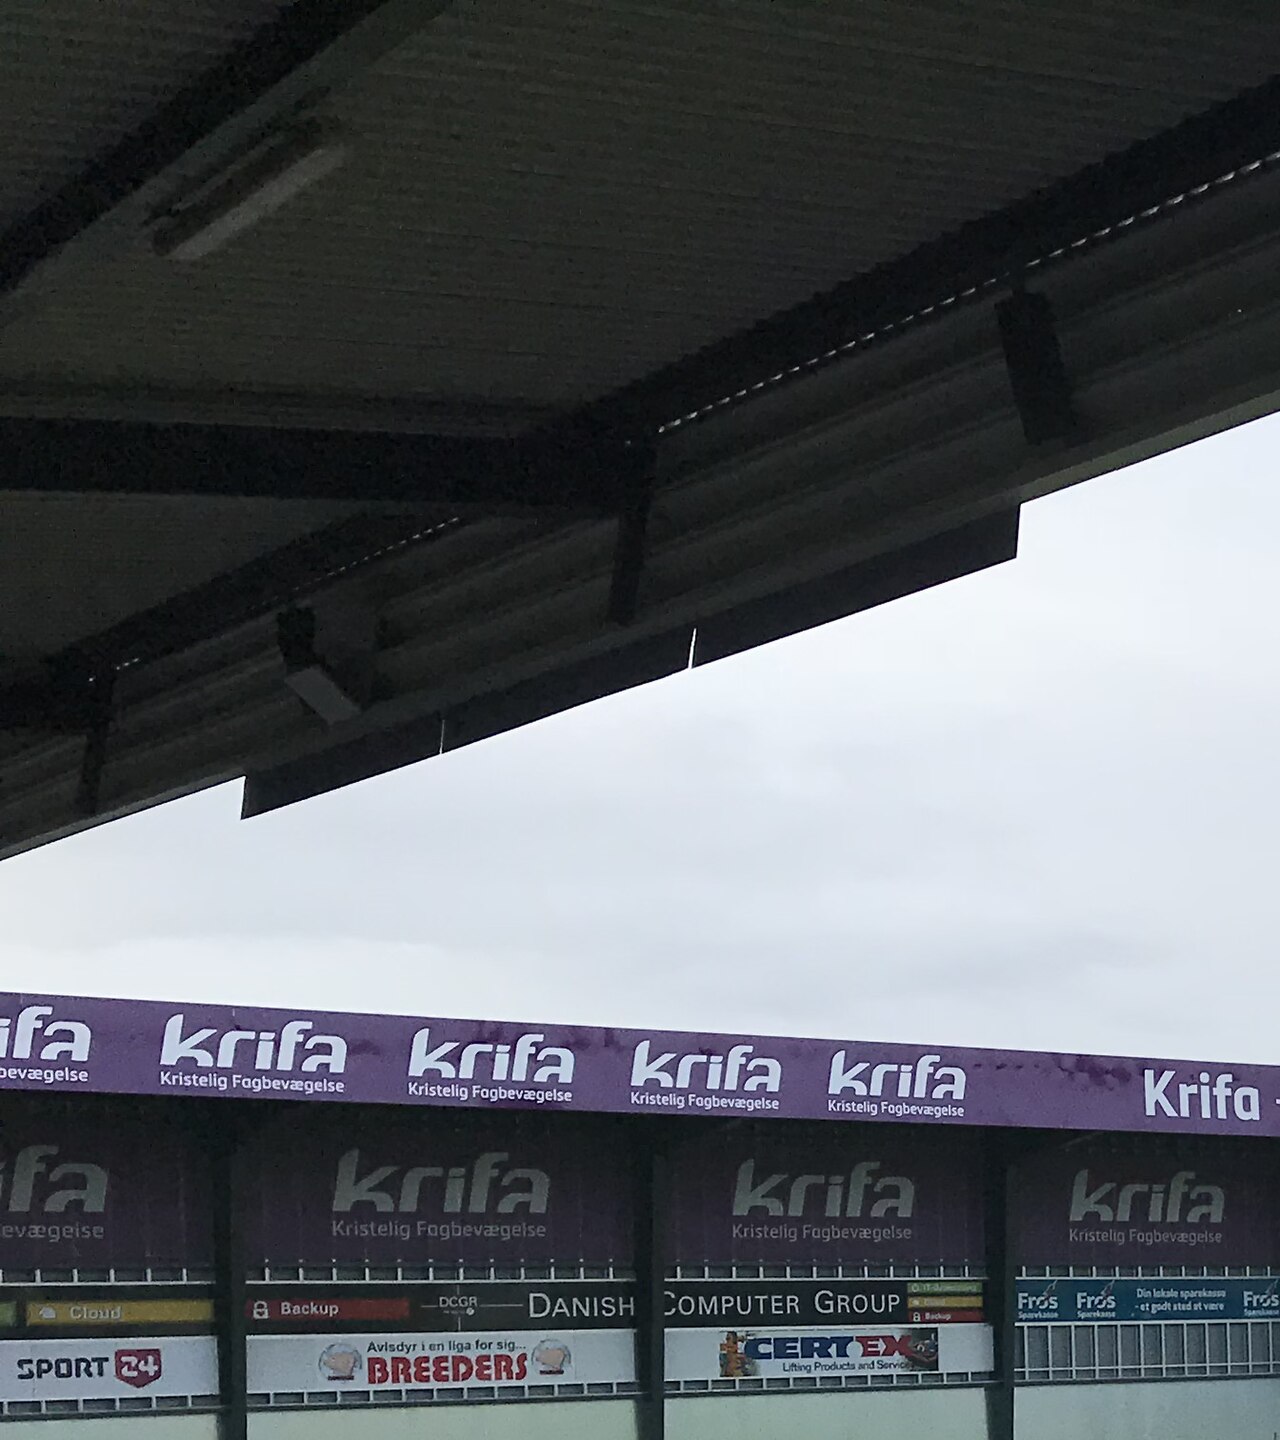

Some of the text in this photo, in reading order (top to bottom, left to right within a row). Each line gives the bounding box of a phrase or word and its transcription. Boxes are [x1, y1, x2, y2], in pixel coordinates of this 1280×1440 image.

[160, 1013, 349, 1074] krifa
[408, 1028, 576, 1084] krifa
[630, 1040, 782, 1093] krifa
[828, 1050, 967, 1101] krifa
[160, 1071, 345, 1095] Kristelig Fagbevægelse
[408, 1082, 573, 1103] Kristelig Fagbevægelse
[1144, 1069, 1261, 1122] Krifa
[630, 1091, 780, 1111] Kristelig Fagbevægelse
[828, 1099, 965, 1118] Kristelig Fagbevægelse
[333, 1149, 551, 1214] krifa
[732, 1158, 915, 1218] krifa
[1069, 1168, 1226, 1223] krifa
[333, 1220, 547, 1240] Kristelig Fagbevægelse
[732, 1223, 913, 1242] Kristelig Fagbevægelse
[1069, 1229, 1224, 1247] Kristelig Fagbevægelse
[69, 1304, 123, 1321] Cloud
[280, 1300, 339, 1319] Backup
[529, 1292, 636, 1319] DANISH
[813, 1289, 900, 1315] GROUP
[743, 1335, 914, 1360] CERTEX
[17, 1355, 160, 1380] SPORT 24
[366, 1352, 528, 1384] BREEDERS
[814, 1361, 856, 1372] Products
[858, 1360, 875, 1371] and
